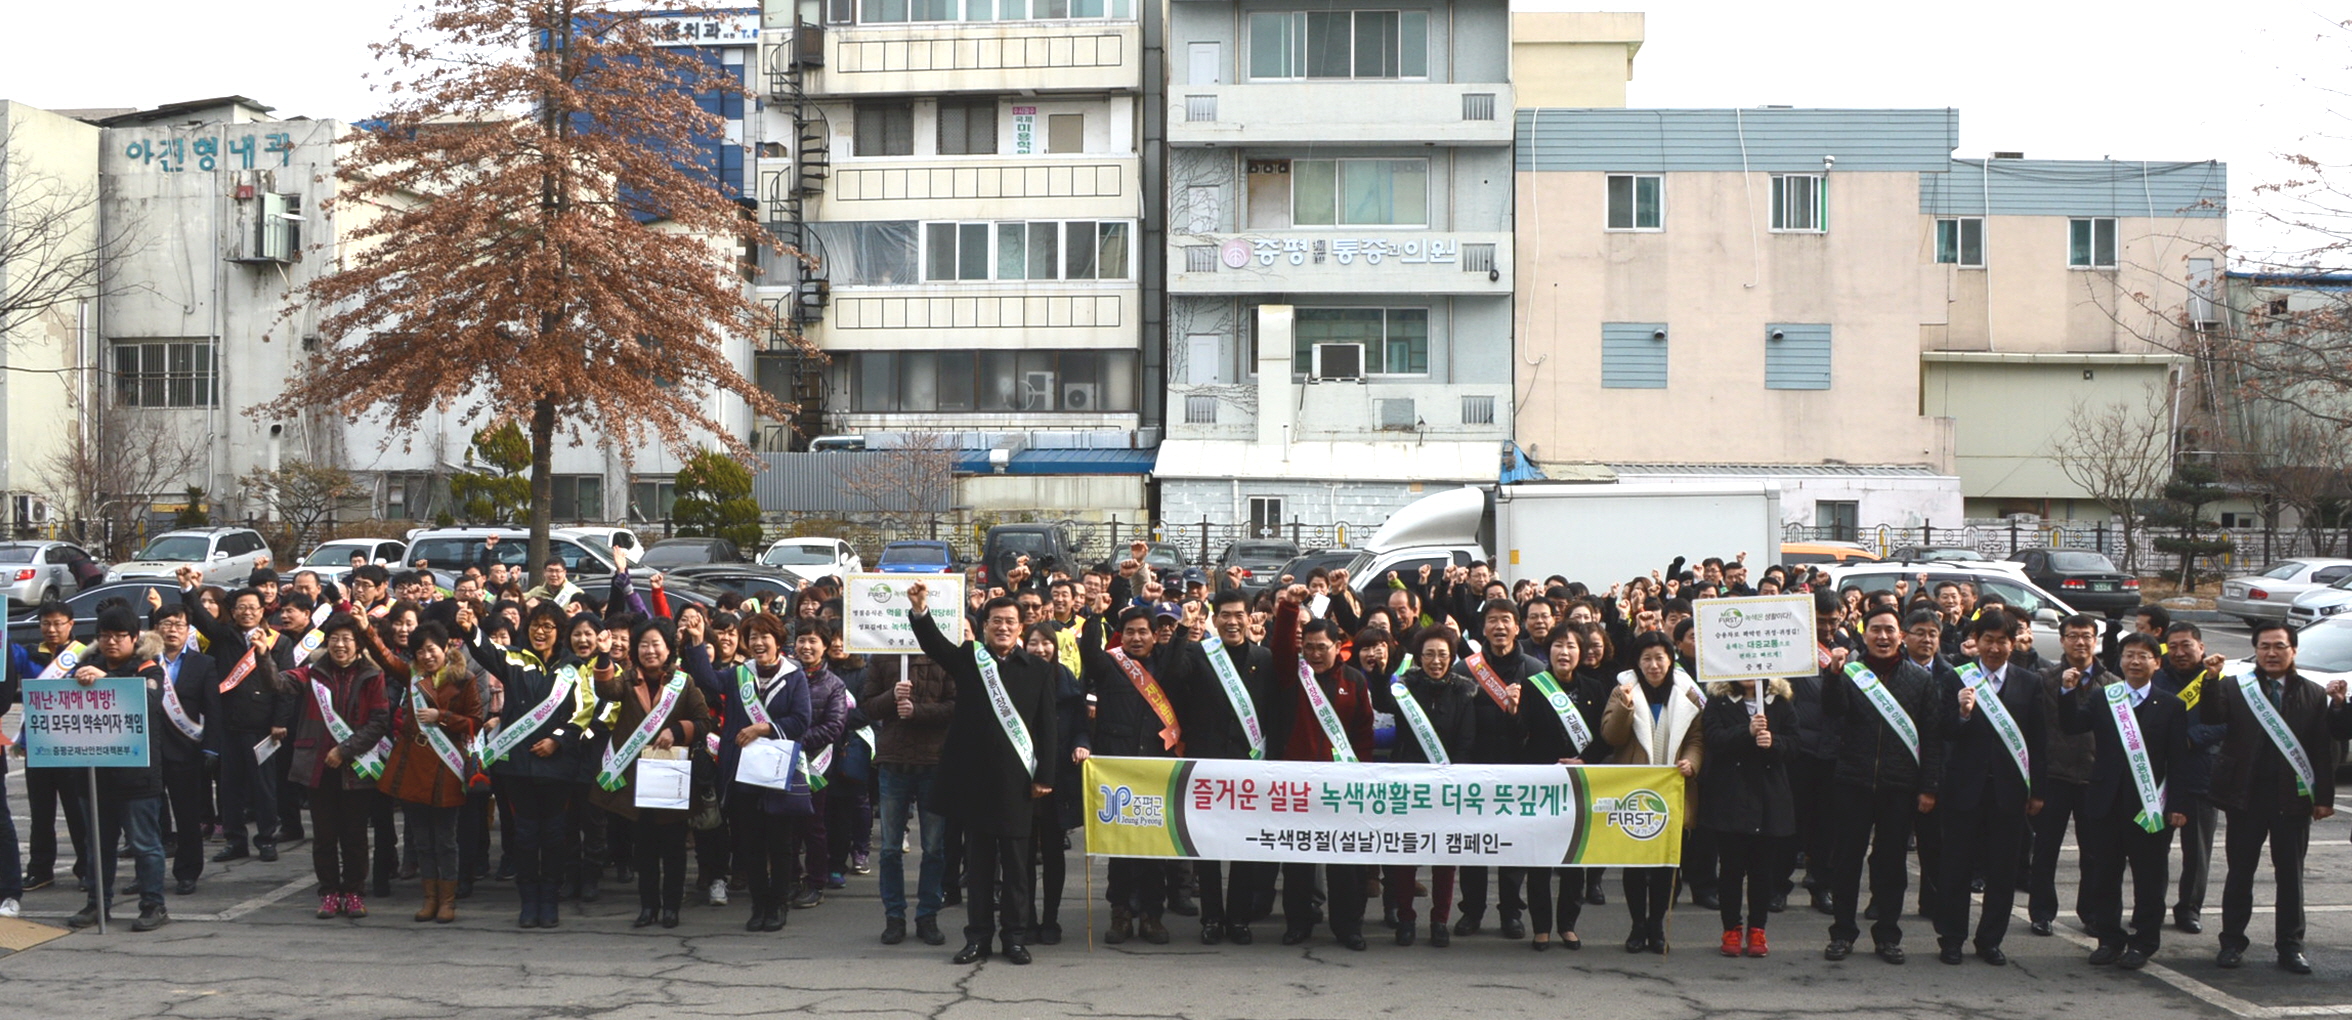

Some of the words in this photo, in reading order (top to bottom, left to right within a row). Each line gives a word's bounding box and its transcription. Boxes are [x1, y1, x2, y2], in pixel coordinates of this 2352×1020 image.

[1253, 238, 1308, 267] 증평
[886, 608, 902, 617] 먹을
[86, 689, 116, 710] 예방!
[984, 667, 1012, 719] 전통시장을
[30, 715, 50, 735] 우리
[52, 715, 81, 735] 모두의
[83, 714, 122, 734] 약속이자
[124, 713, 144, 734] 책임
[643, 691, 676, 734] 전통시장을
[496, 717, 536, 751] 애용합시다
[1319, 706, 1348, 752] 애용합시다
[613, 731, 648, 771] 애용합시다
[2115, 704, 2141, 751] 전통시장을
[2132, 752, 2157, 803] 애용합시다
[1133, 796, 1162, 816] 증평군
[1193, 779, 1259, 811] 즐거운
[1267, 780, 1313, 812] 설날
[1320, 781, 1433, 816] 녹색생활로
[1442, 783, 1485, 815] 더욱
[1493, 783, 1568, 816] 뜻깊게!
[1614, 799, 1638, 811] ME
[1121, 816, 1139, 826] Jeung
[1140, 816, 1163, 826] Pyeong
[1608, 812, 1654, 826] FIRST
